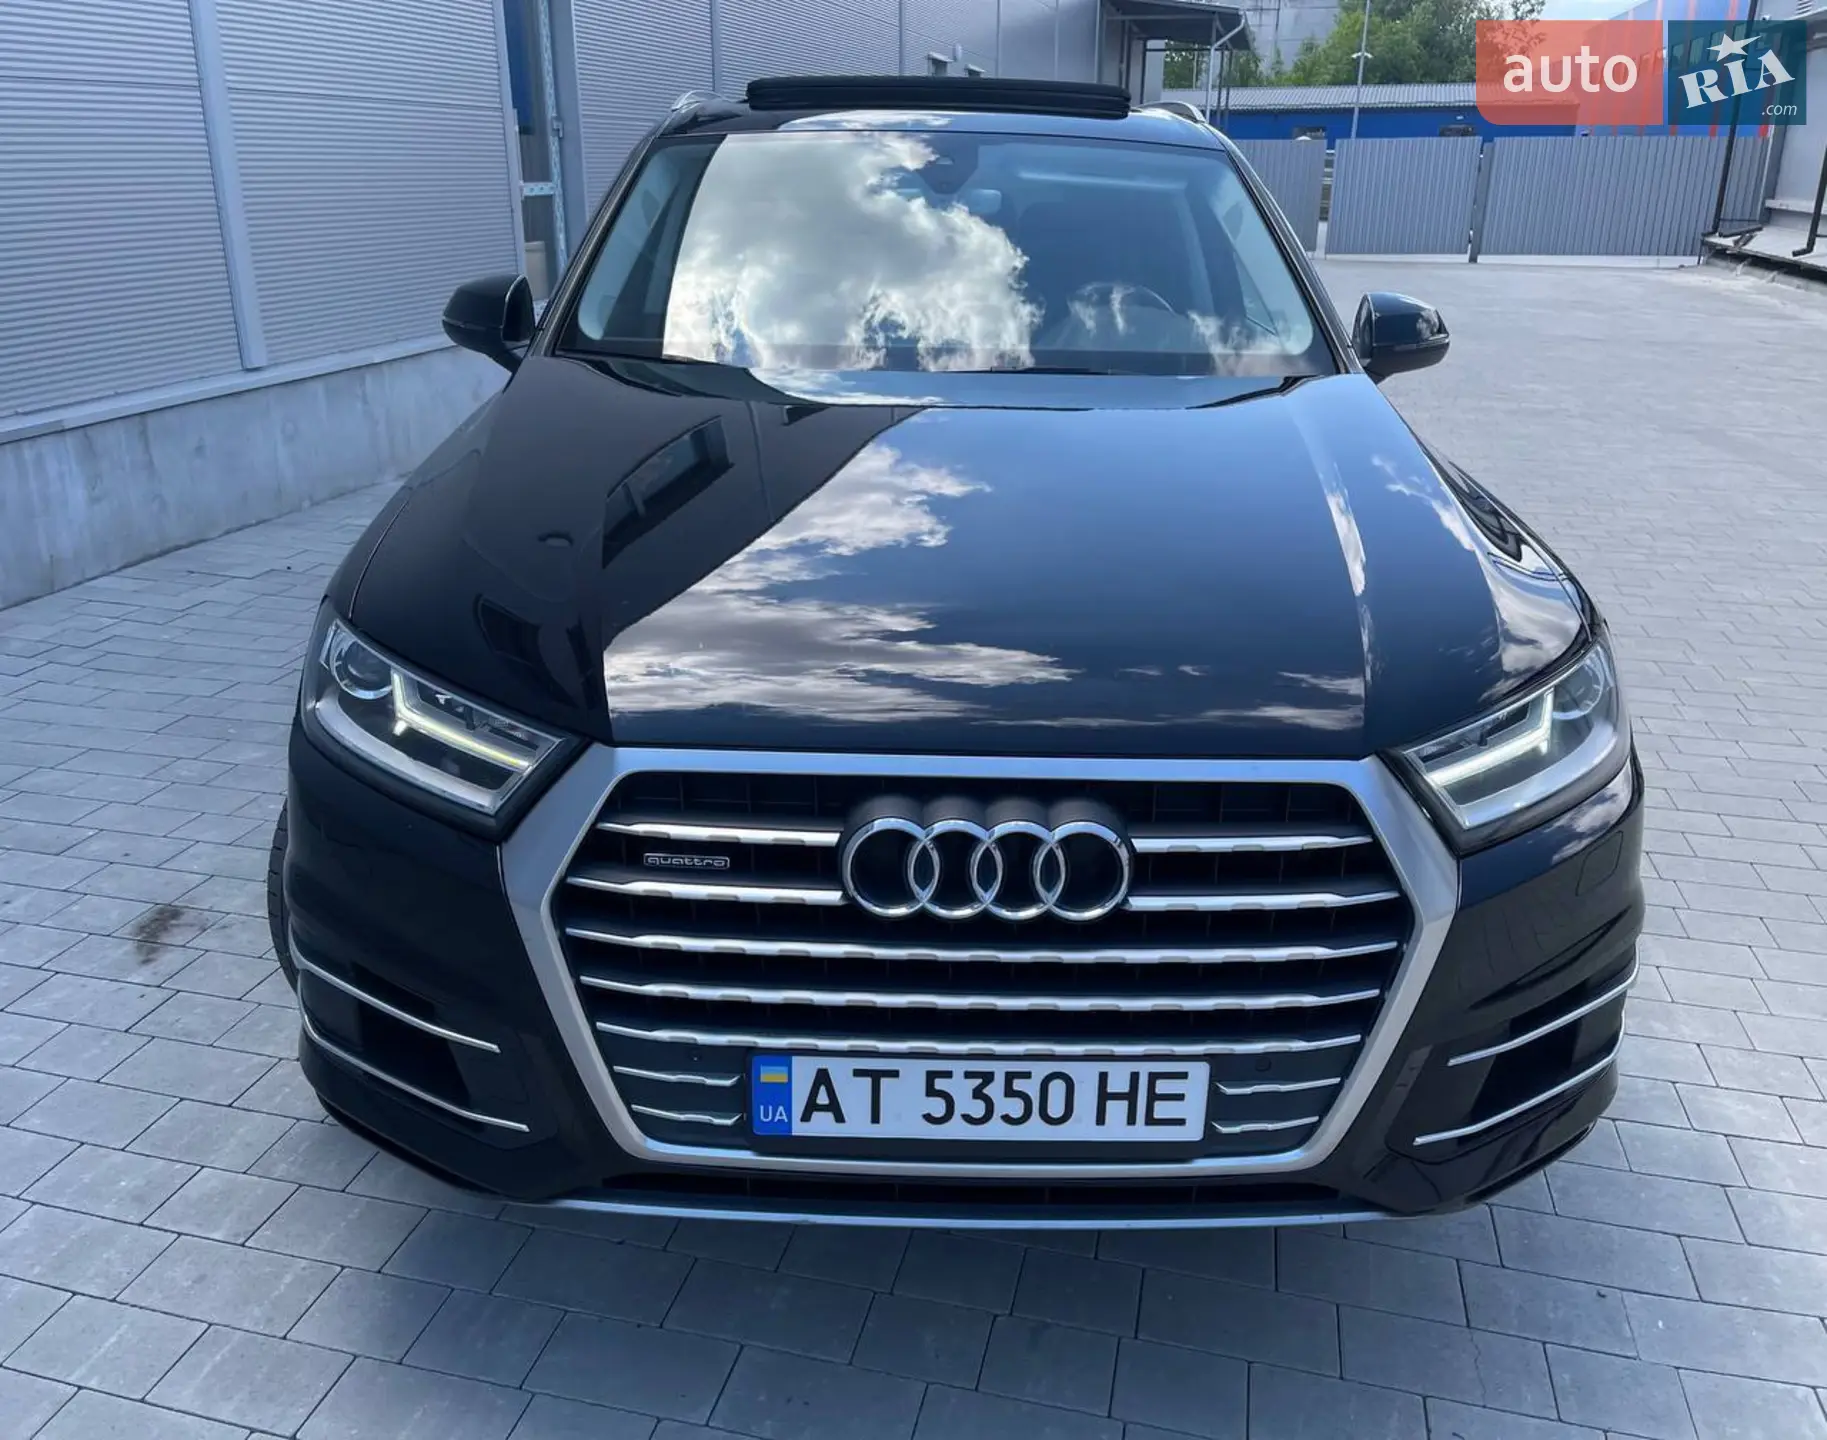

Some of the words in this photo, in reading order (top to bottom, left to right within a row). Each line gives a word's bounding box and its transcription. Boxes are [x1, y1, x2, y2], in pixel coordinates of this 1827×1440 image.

[647, 856, 726, 868] quattro
[800, 1067, 900, 1124] AT
[921, 1069, 1076, 1126] 5350
[1095, 1070, 1189, 1127] HE
[759, 1104, 789, 1123] UA
